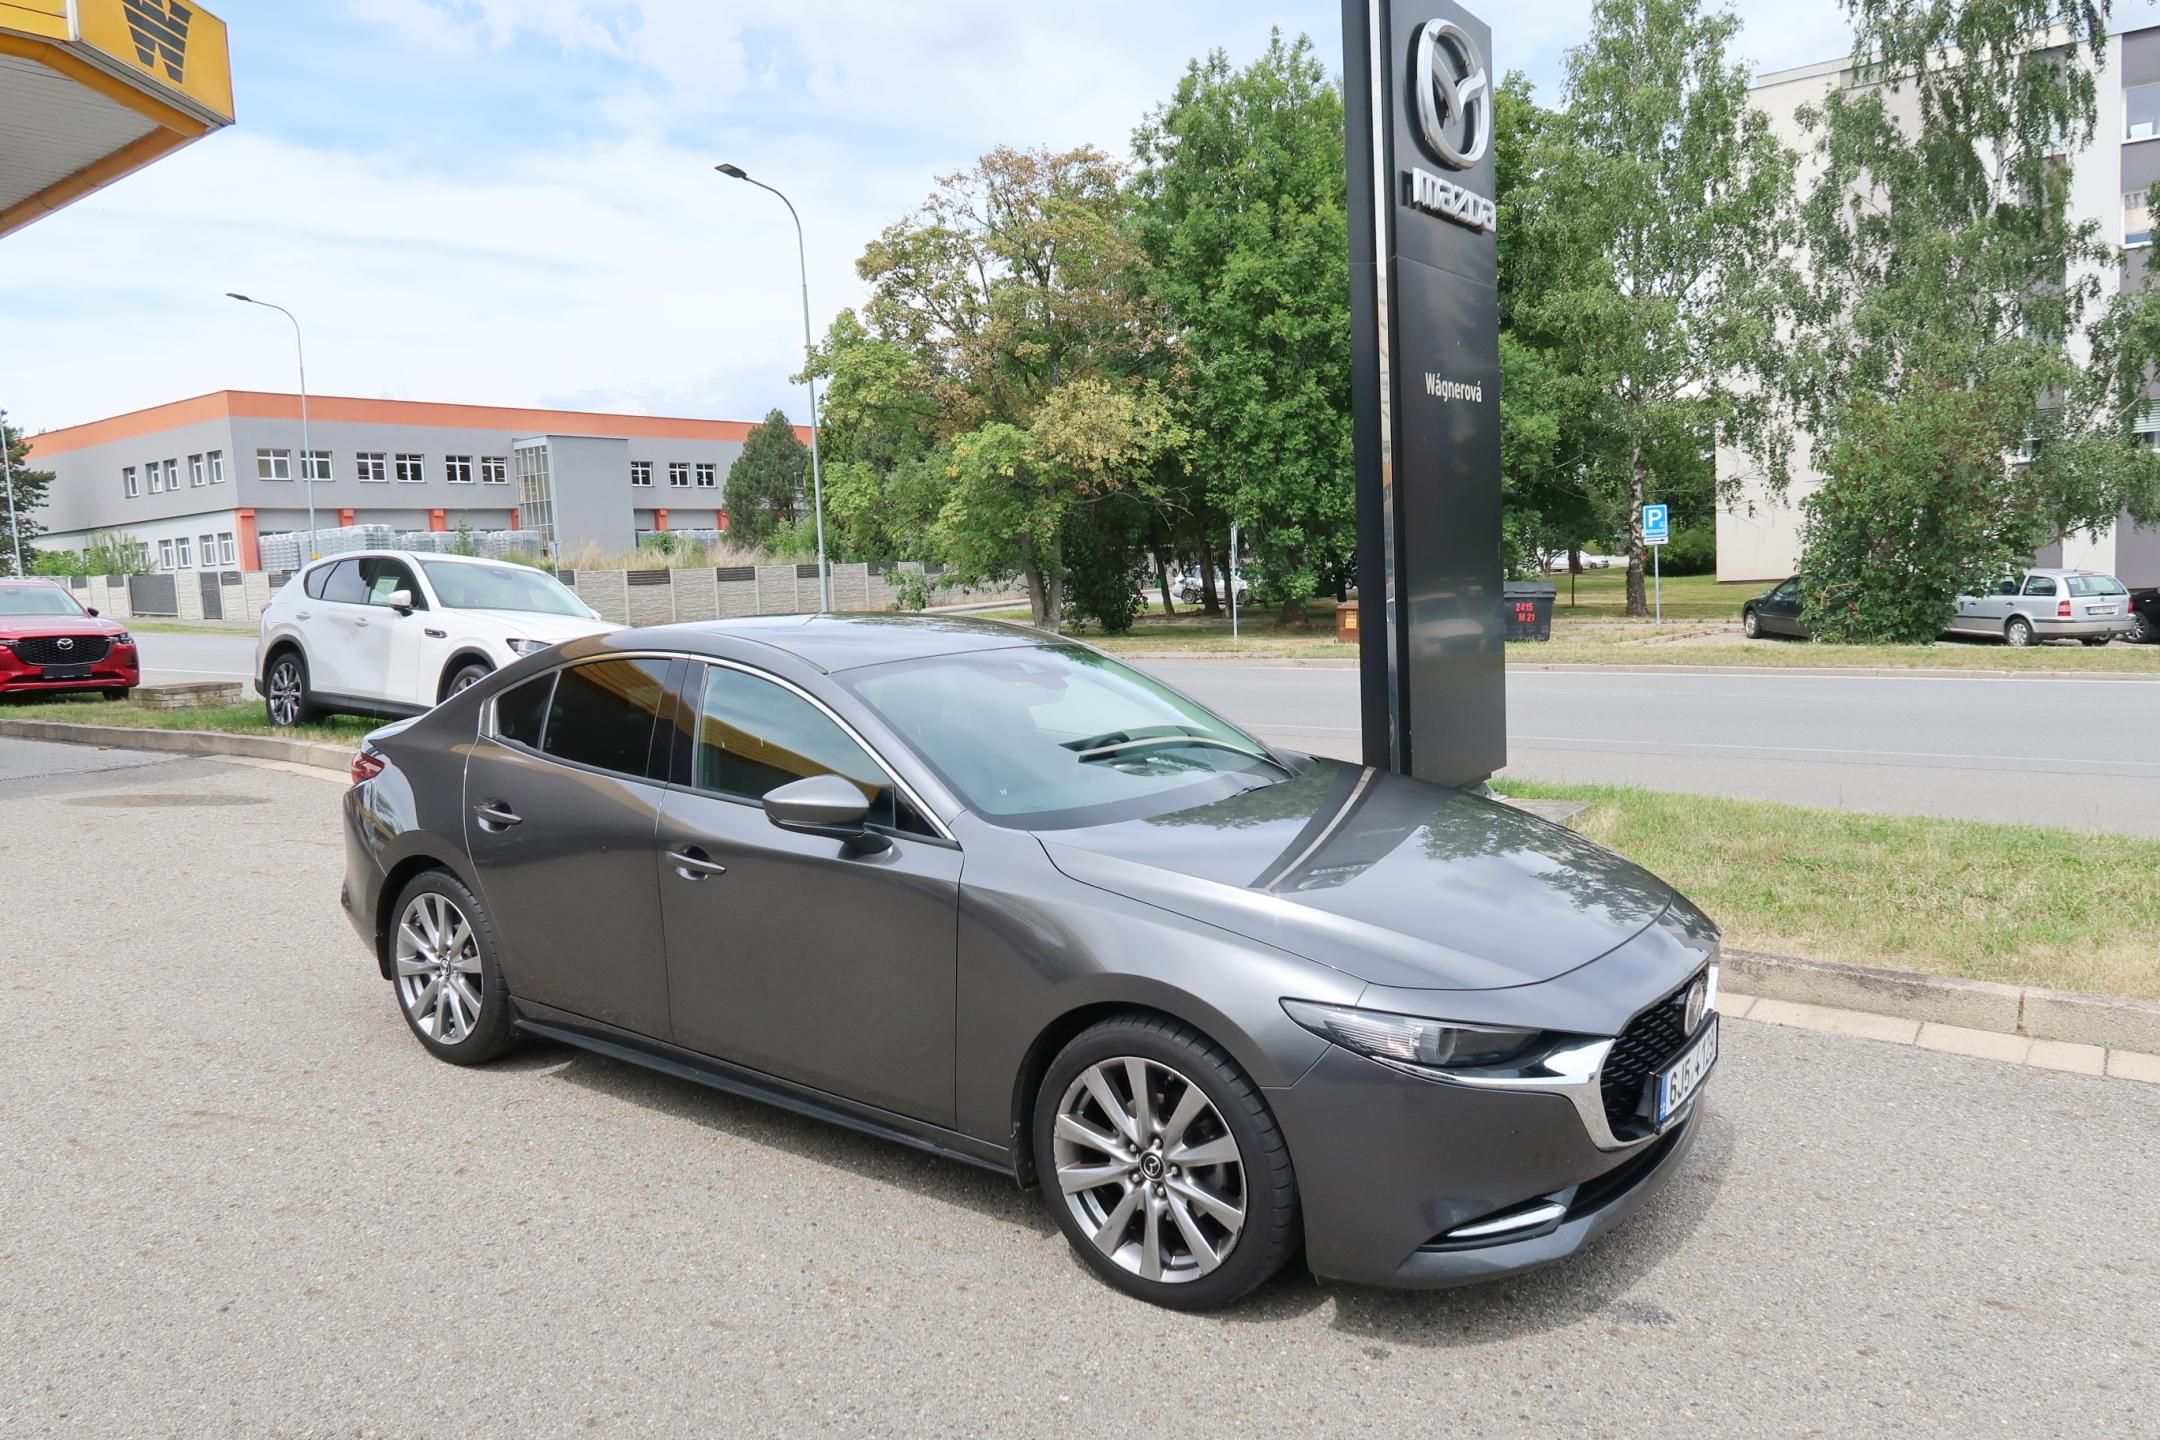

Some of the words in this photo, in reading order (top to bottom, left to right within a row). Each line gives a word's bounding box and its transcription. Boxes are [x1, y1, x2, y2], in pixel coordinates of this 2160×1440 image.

[1425, 372, 1482, 403] Wágnerová
[1648, 509, 1662, 528] P
[1515, 603, 1534, 612] 2415
